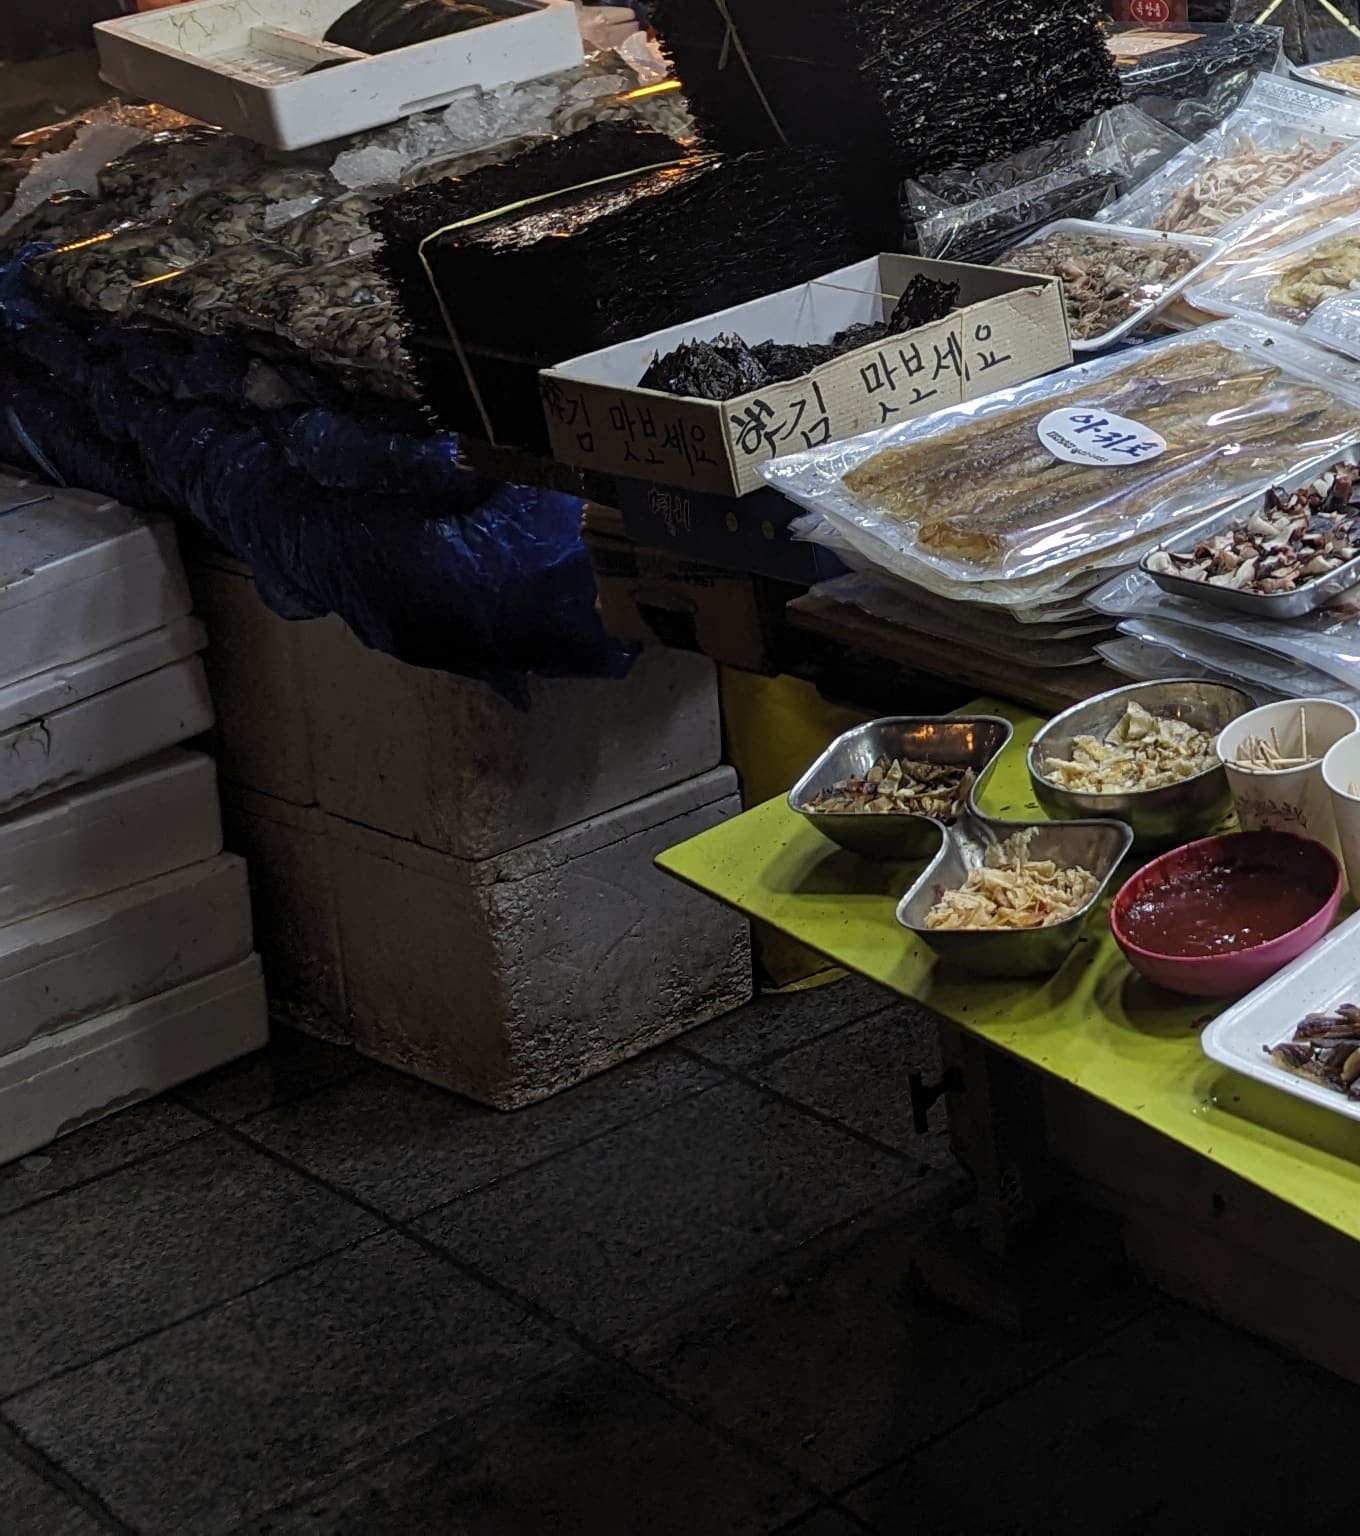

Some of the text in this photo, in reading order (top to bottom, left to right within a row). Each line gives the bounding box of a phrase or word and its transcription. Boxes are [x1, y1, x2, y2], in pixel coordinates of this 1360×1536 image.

[861, 324, 1012, 424] 맛보세요
[610, 400, 719, 476] 맛보세요
[1069, 412, 1156, 457] 아귀포
